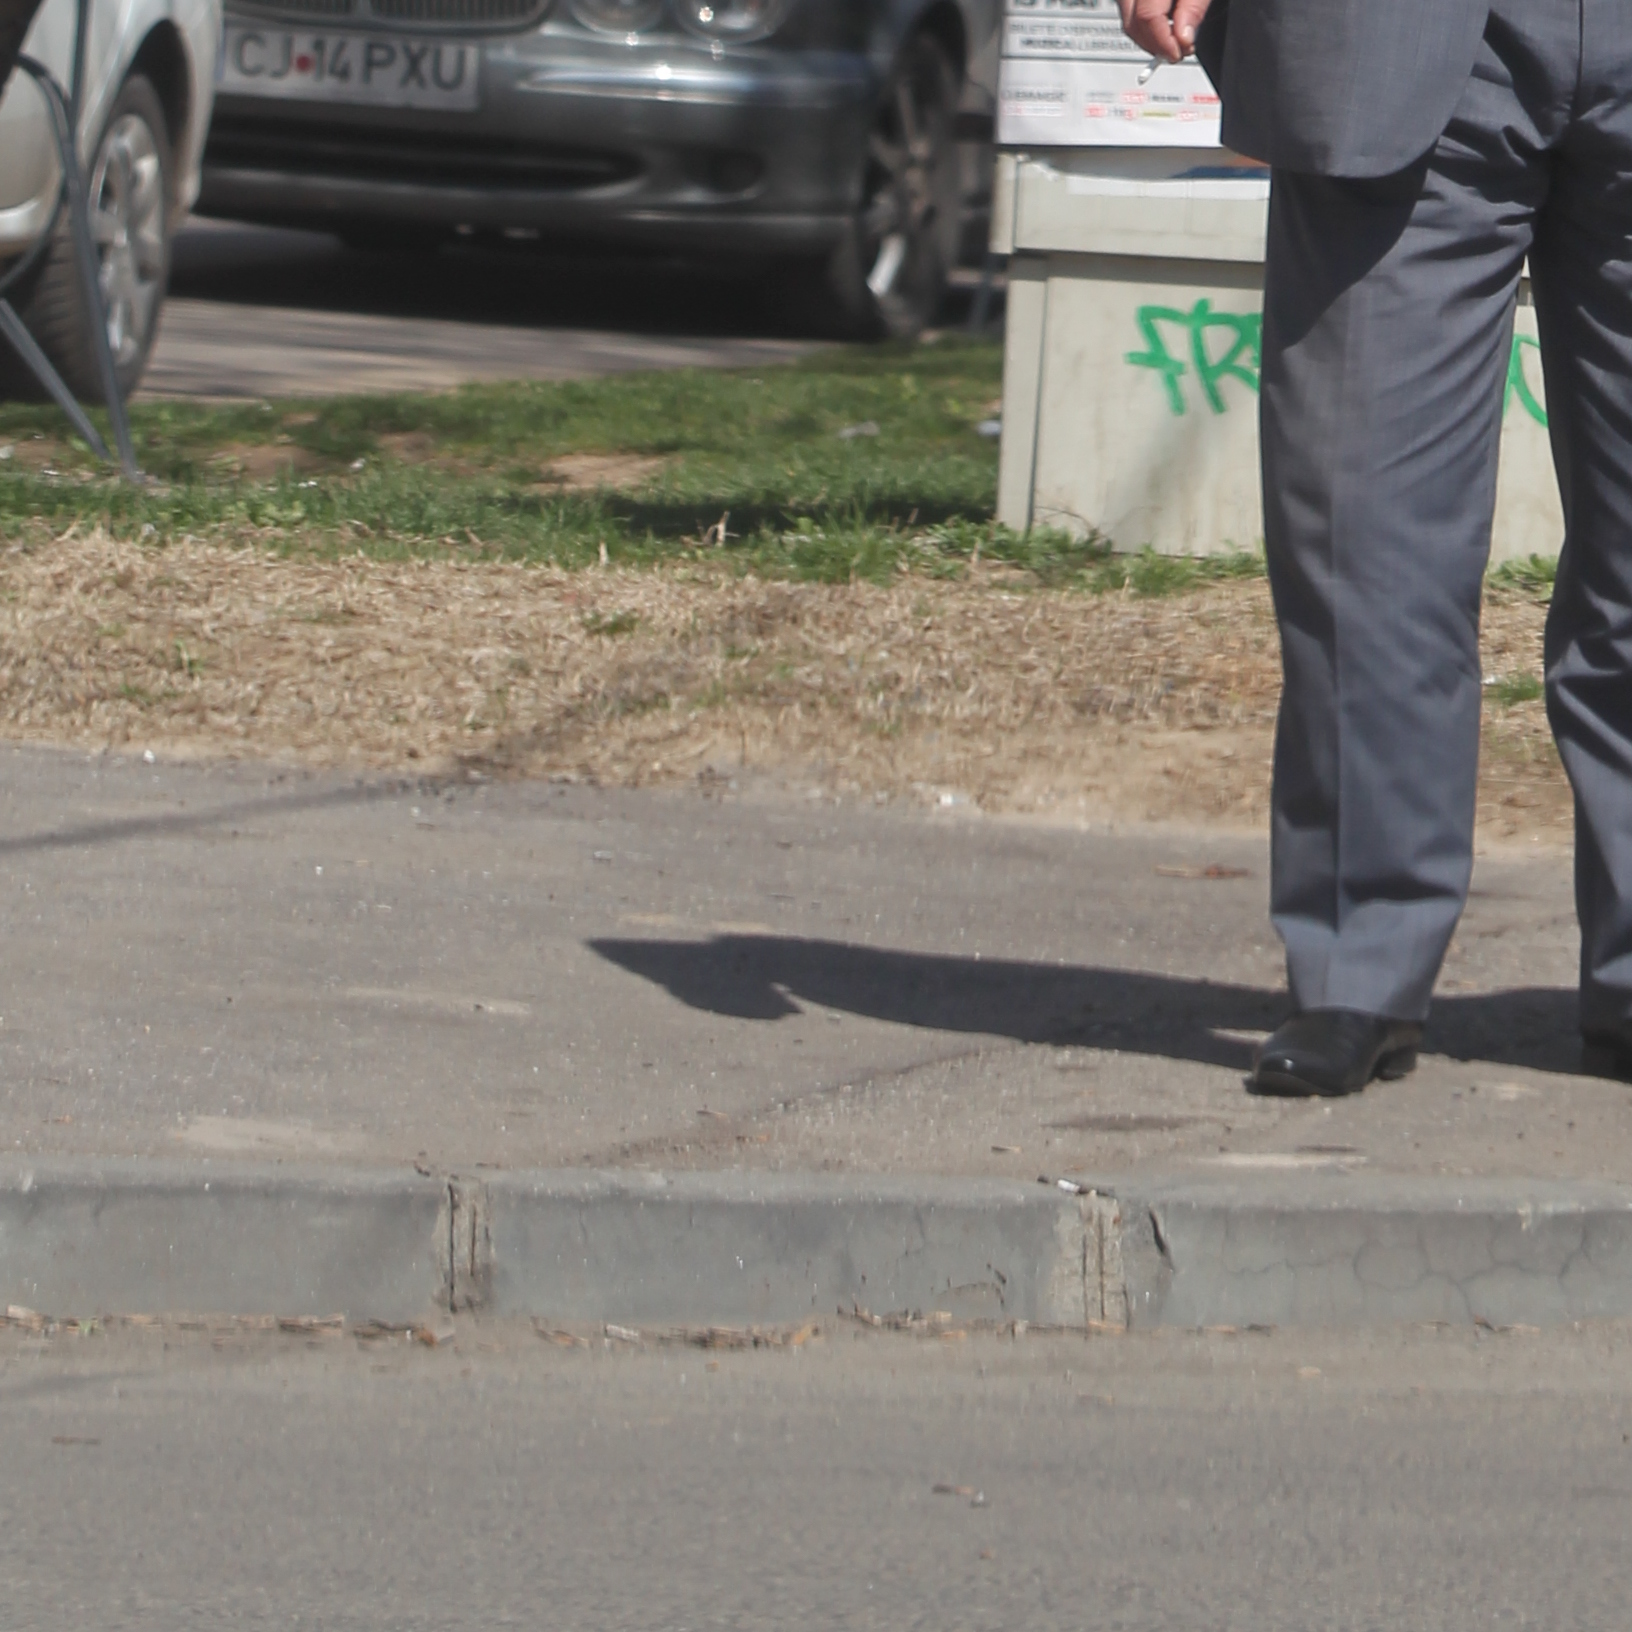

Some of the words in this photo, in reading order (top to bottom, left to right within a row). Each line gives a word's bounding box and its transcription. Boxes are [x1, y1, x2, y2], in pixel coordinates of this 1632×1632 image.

[234, 33, 295, 78] CJ
[312, 40, 351, 81] 14
[361, 42, 466, 91] PXU
